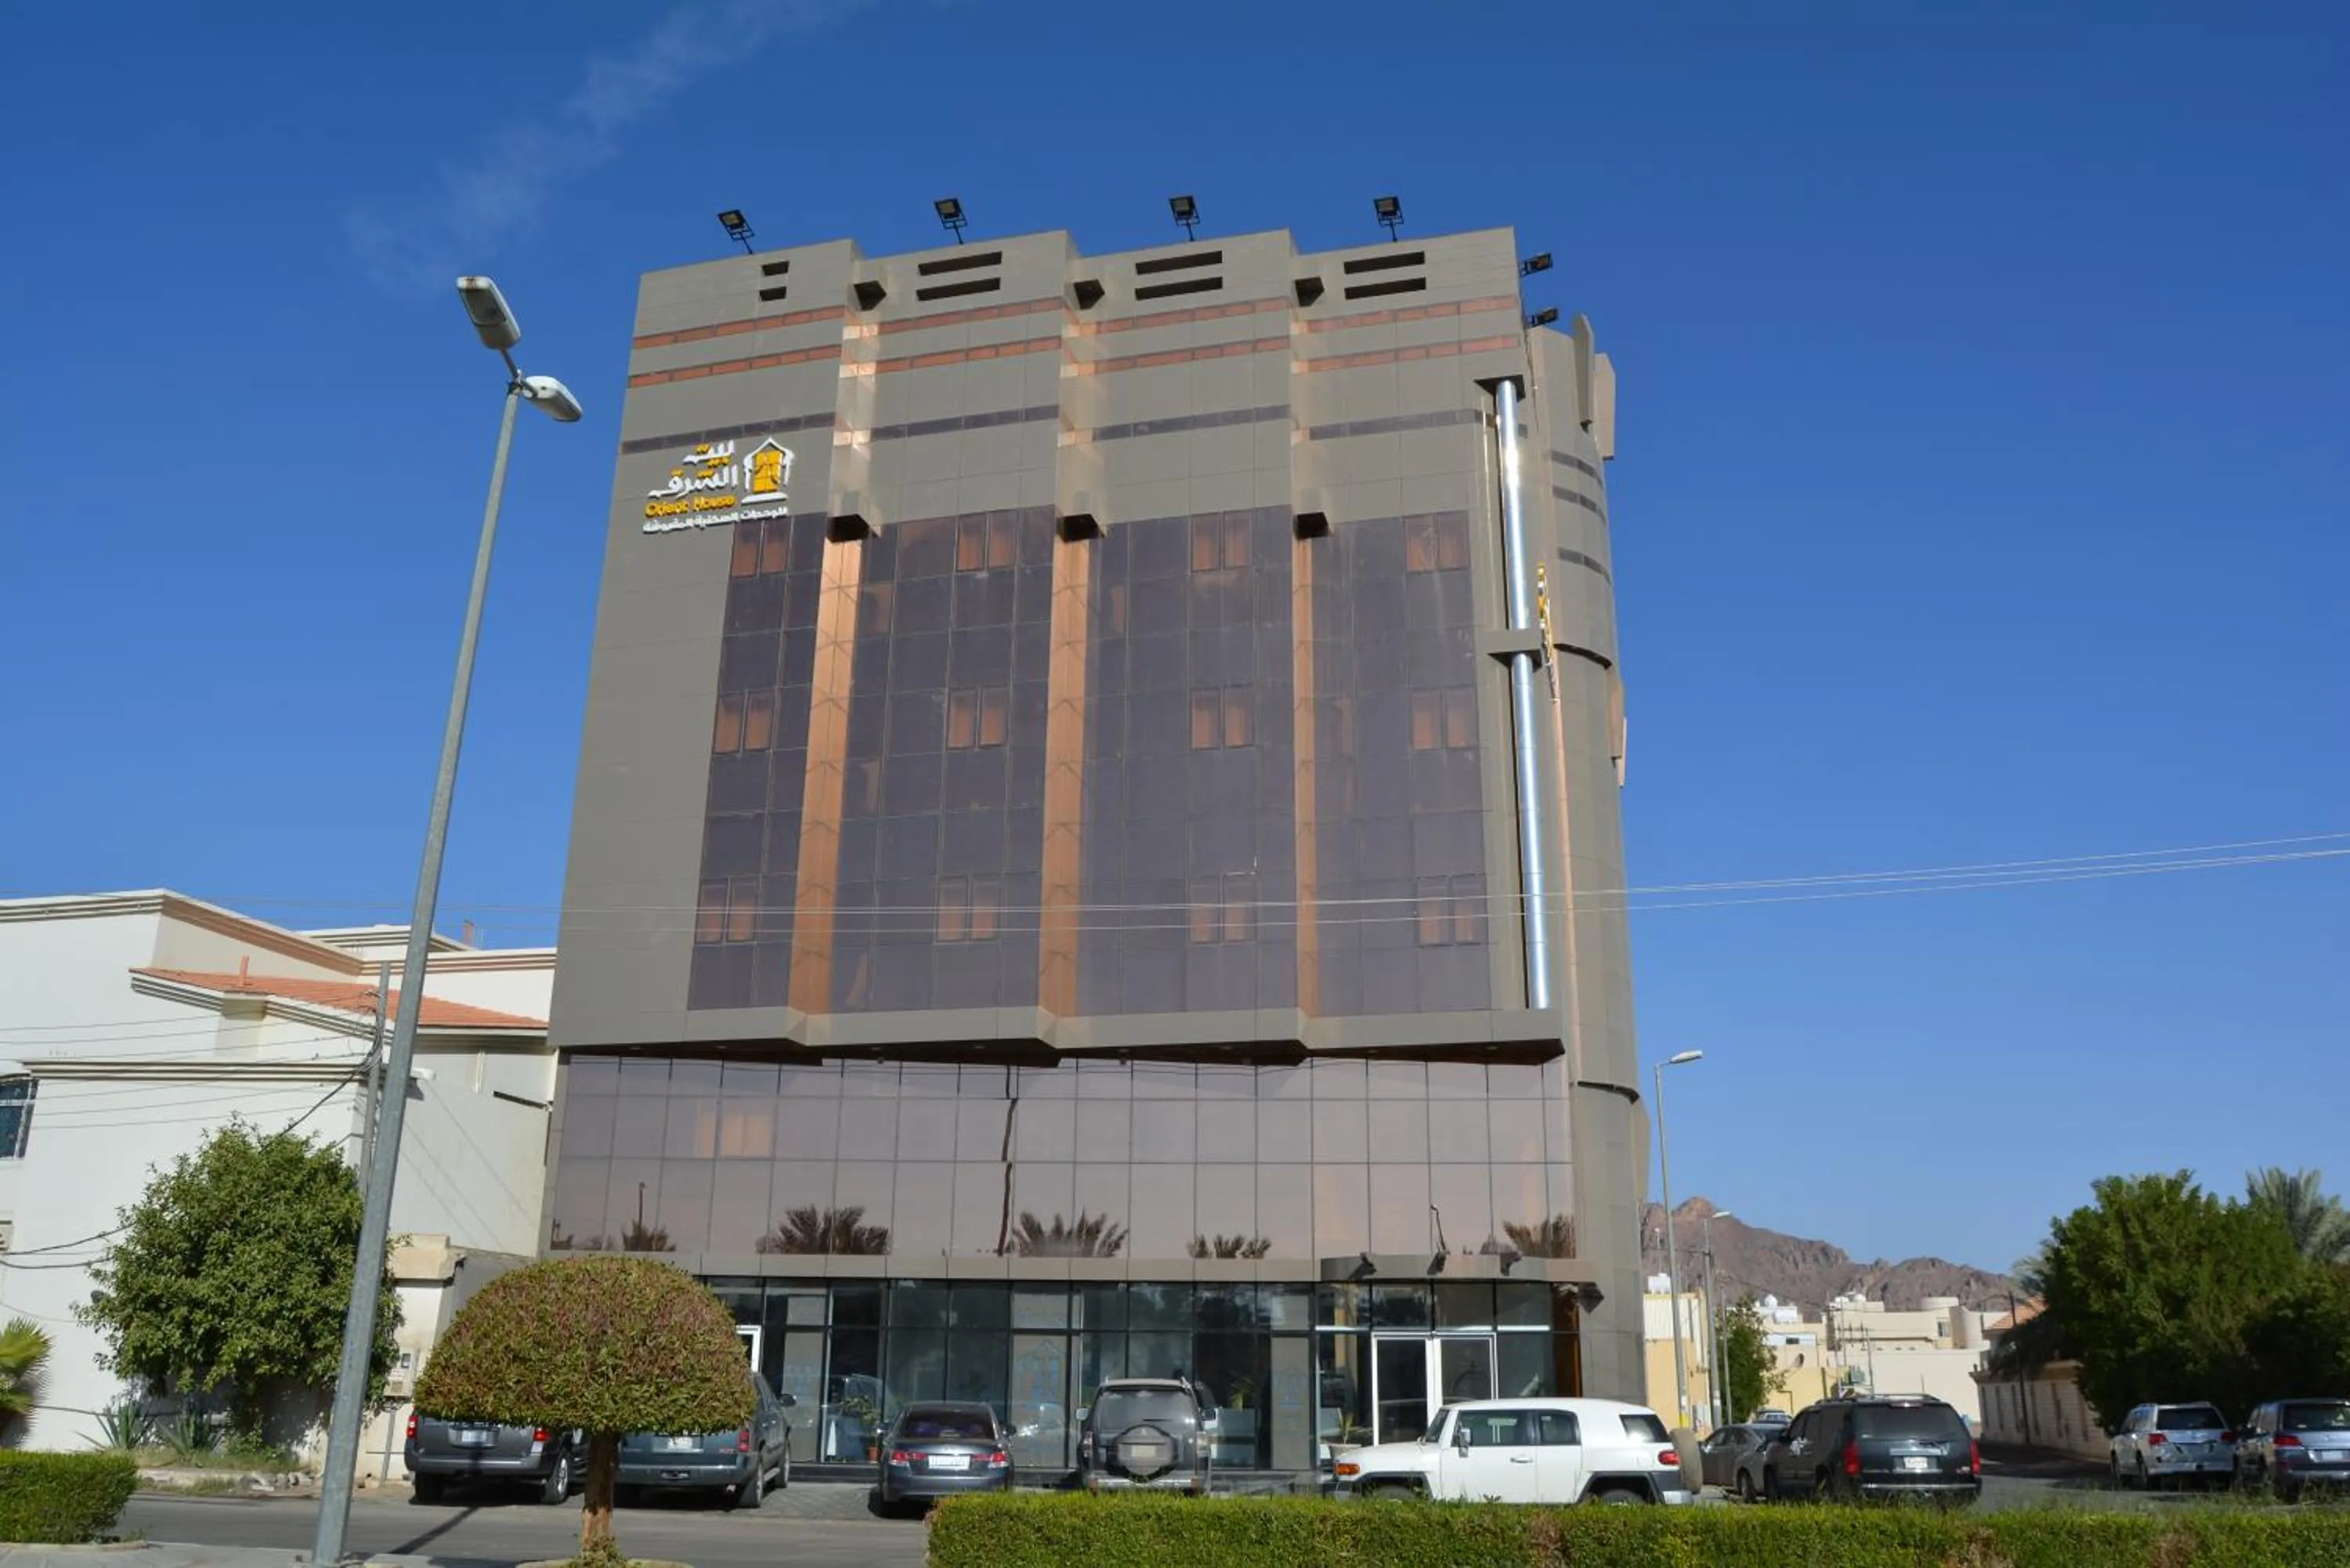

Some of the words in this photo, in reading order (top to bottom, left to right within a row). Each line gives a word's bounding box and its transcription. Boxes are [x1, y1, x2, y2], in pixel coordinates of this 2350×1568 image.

[682, 439, 736, 467] بيت
[648, 464, 739, 499] الشرق
[645, 500, 689, 518] Orient
[692, 494, 737, 512] House
